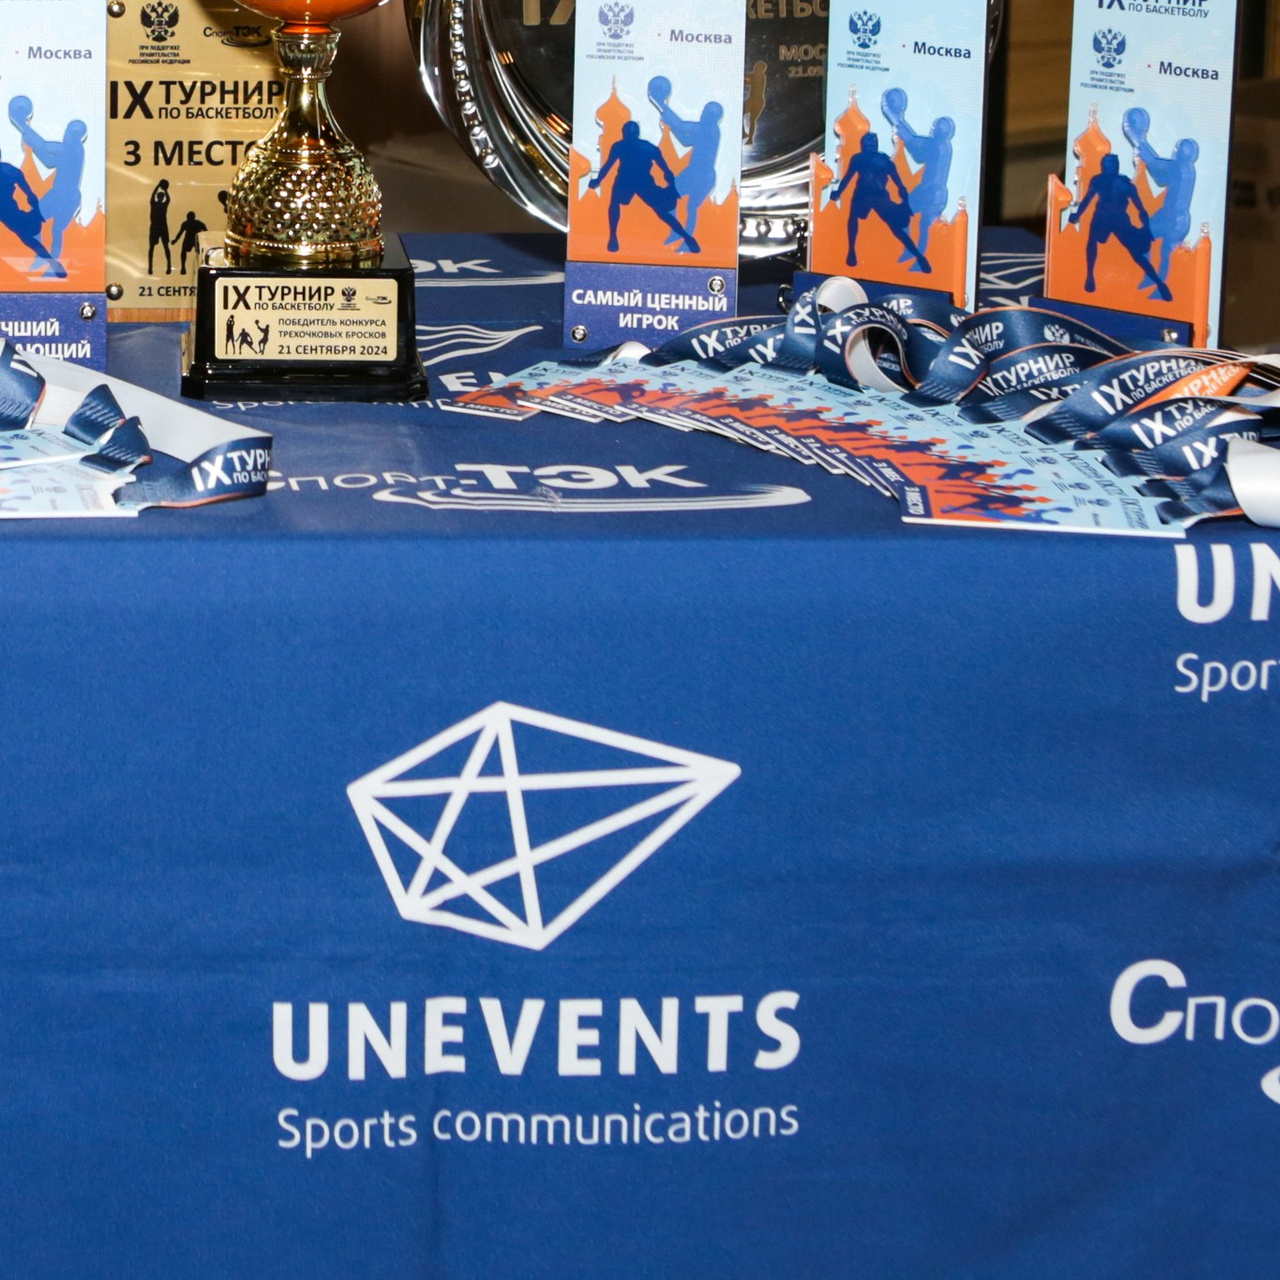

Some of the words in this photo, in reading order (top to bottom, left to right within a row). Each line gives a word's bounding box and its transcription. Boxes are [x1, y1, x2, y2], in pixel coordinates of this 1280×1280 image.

[1128, 2, 1143, 13] ПО
[1145, 3, 1210, 19] БАСКЕТБОЛУ
[669, 29, 732, 45] Москва
[27, 45, 92, 60] Москва
[912, 41, 972, 59] Москва
[1158, 61, 1220, 81] Москва
[109, 80, 154, 120] IX
[158, 80, 285, 105] ТУРНИР
[158, 107, 182, 119] ПО
[123, 140, 141, 166] 3
[138, 286, 153, 297] 21
[222, 286, 251, 310] IX
[254, 285, 336, 302] ТУРНИР
[571, 288, 643, 308] САМЫЙ
[646, 292, 728, 312] ЦЕННЫЙ
[254, 302, 269, 310] ПО
[272, 302, 336, 311] БАСКЕТБОЛУ
[278, 318, 337, 327] ПОБЕДИТЕЛЬ
[339, 319, 387, 327] КОНКУРСА
[618, 312, 679, 331] ИГРОК
[794, 302, 816, 334] IX
[278, 330, 343, 338] ТРЕХОЧКОВЫХ
[346, 331, 387, 339] БРОСКОВ
[690, 329, 726, 359] IX
[823, 318, 853, 354] IX
[278, 345, 291, 355] 21
[295, 345, 356, 355] СЕНТЯБРЯ
[360, 345, 388, 355] 2024
[993, 353, 1075, 389] ТУРНИР
[1091, 378, 1134, 415] IX
[1130, 389, 1146, 402] ПО
[468, 403, 519, 415] МЕСТО
[1131, 411, 1177, 449] IX
[1174, 415, 1193, 431] ПО
[1182, 436, 1218, 470] IX
[191, 455, 232, 492] IX
[233, 471, 249, 484] ПО
[1174, 542, 1280, 624] UN
[271, 989, 801, 1081] UNEVENTS
[277, 1106, 418, 1159] Sports
[432, 1101, 799, 1148] communications
